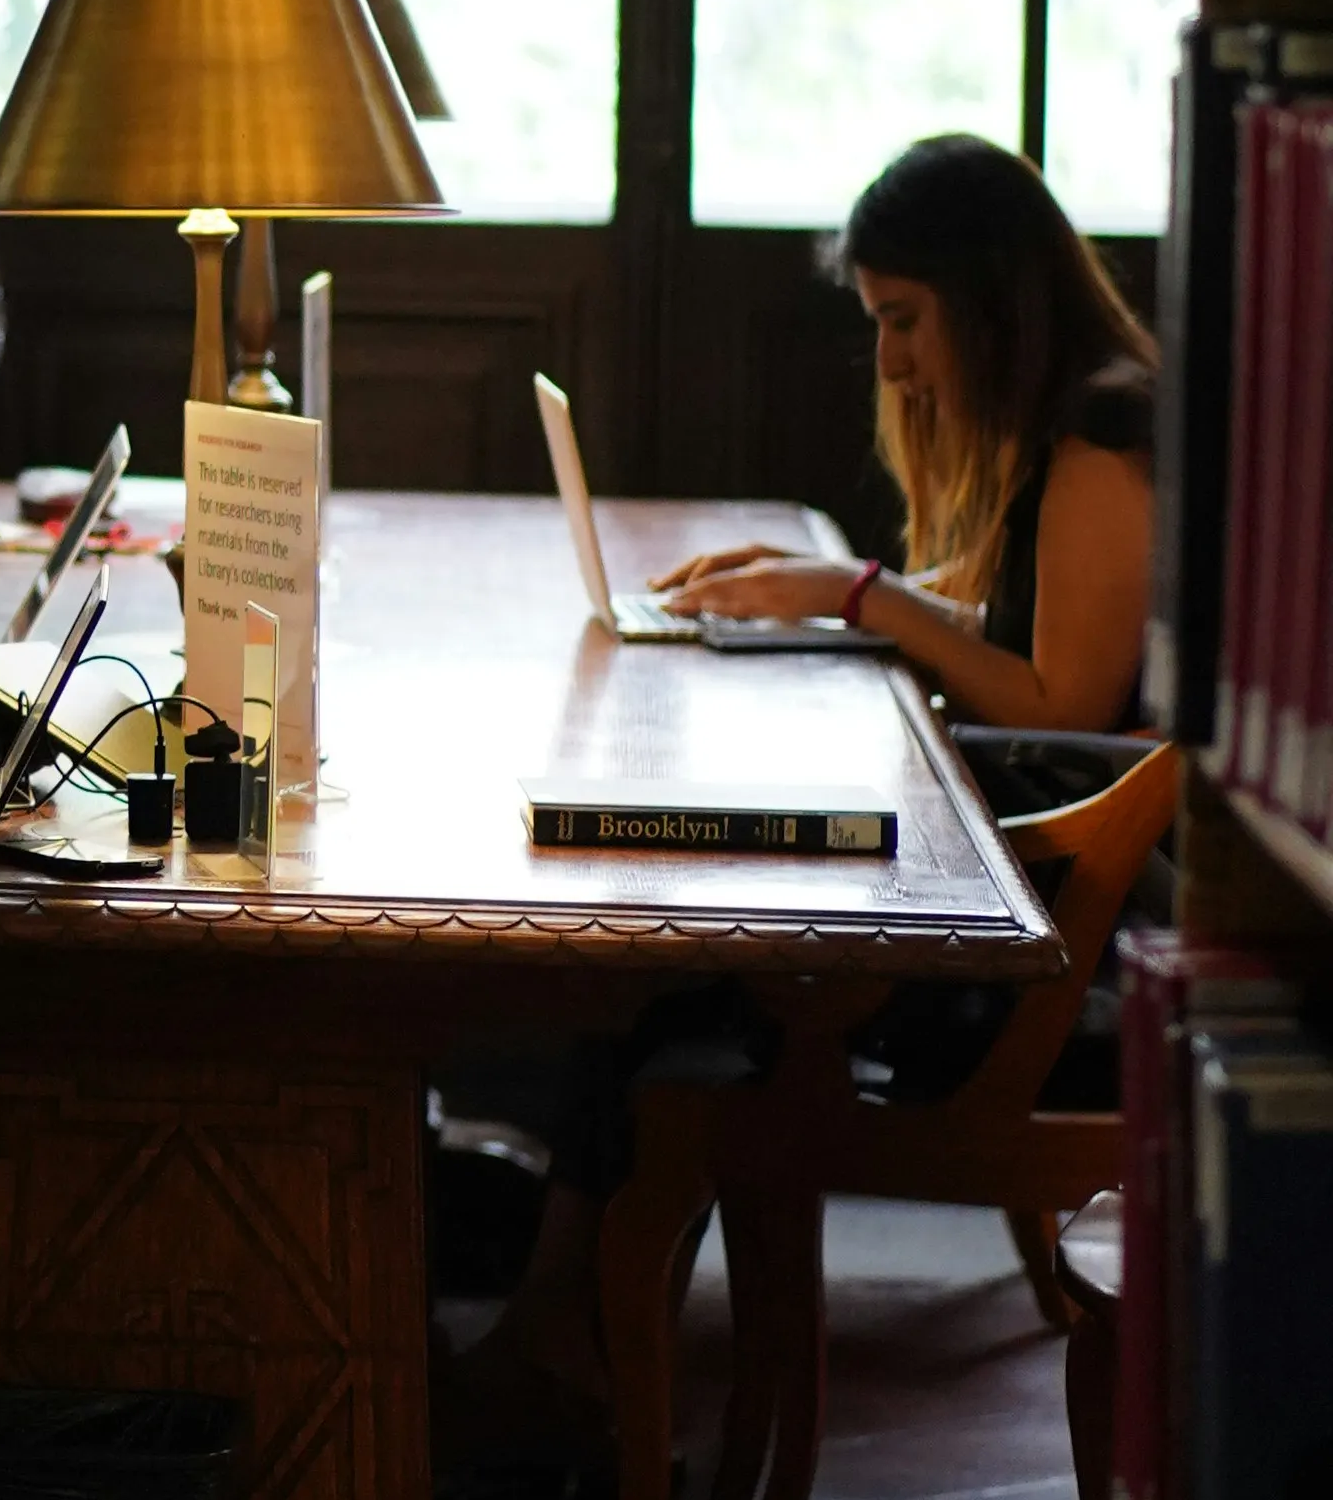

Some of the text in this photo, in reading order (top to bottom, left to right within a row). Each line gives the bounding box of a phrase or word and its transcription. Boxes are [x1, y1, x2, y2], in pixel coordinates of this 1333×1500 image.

[198, 461, 302, 497] This table is reserved
[198, 493, 302, 536] for researchers using
[198, 528, 289, 559] materials from the
[198, 556, 297, 594] Library's collections.
[198, 598, 239, 621] Thank you.
[597, 813, 730, 843] Brooklyn!
